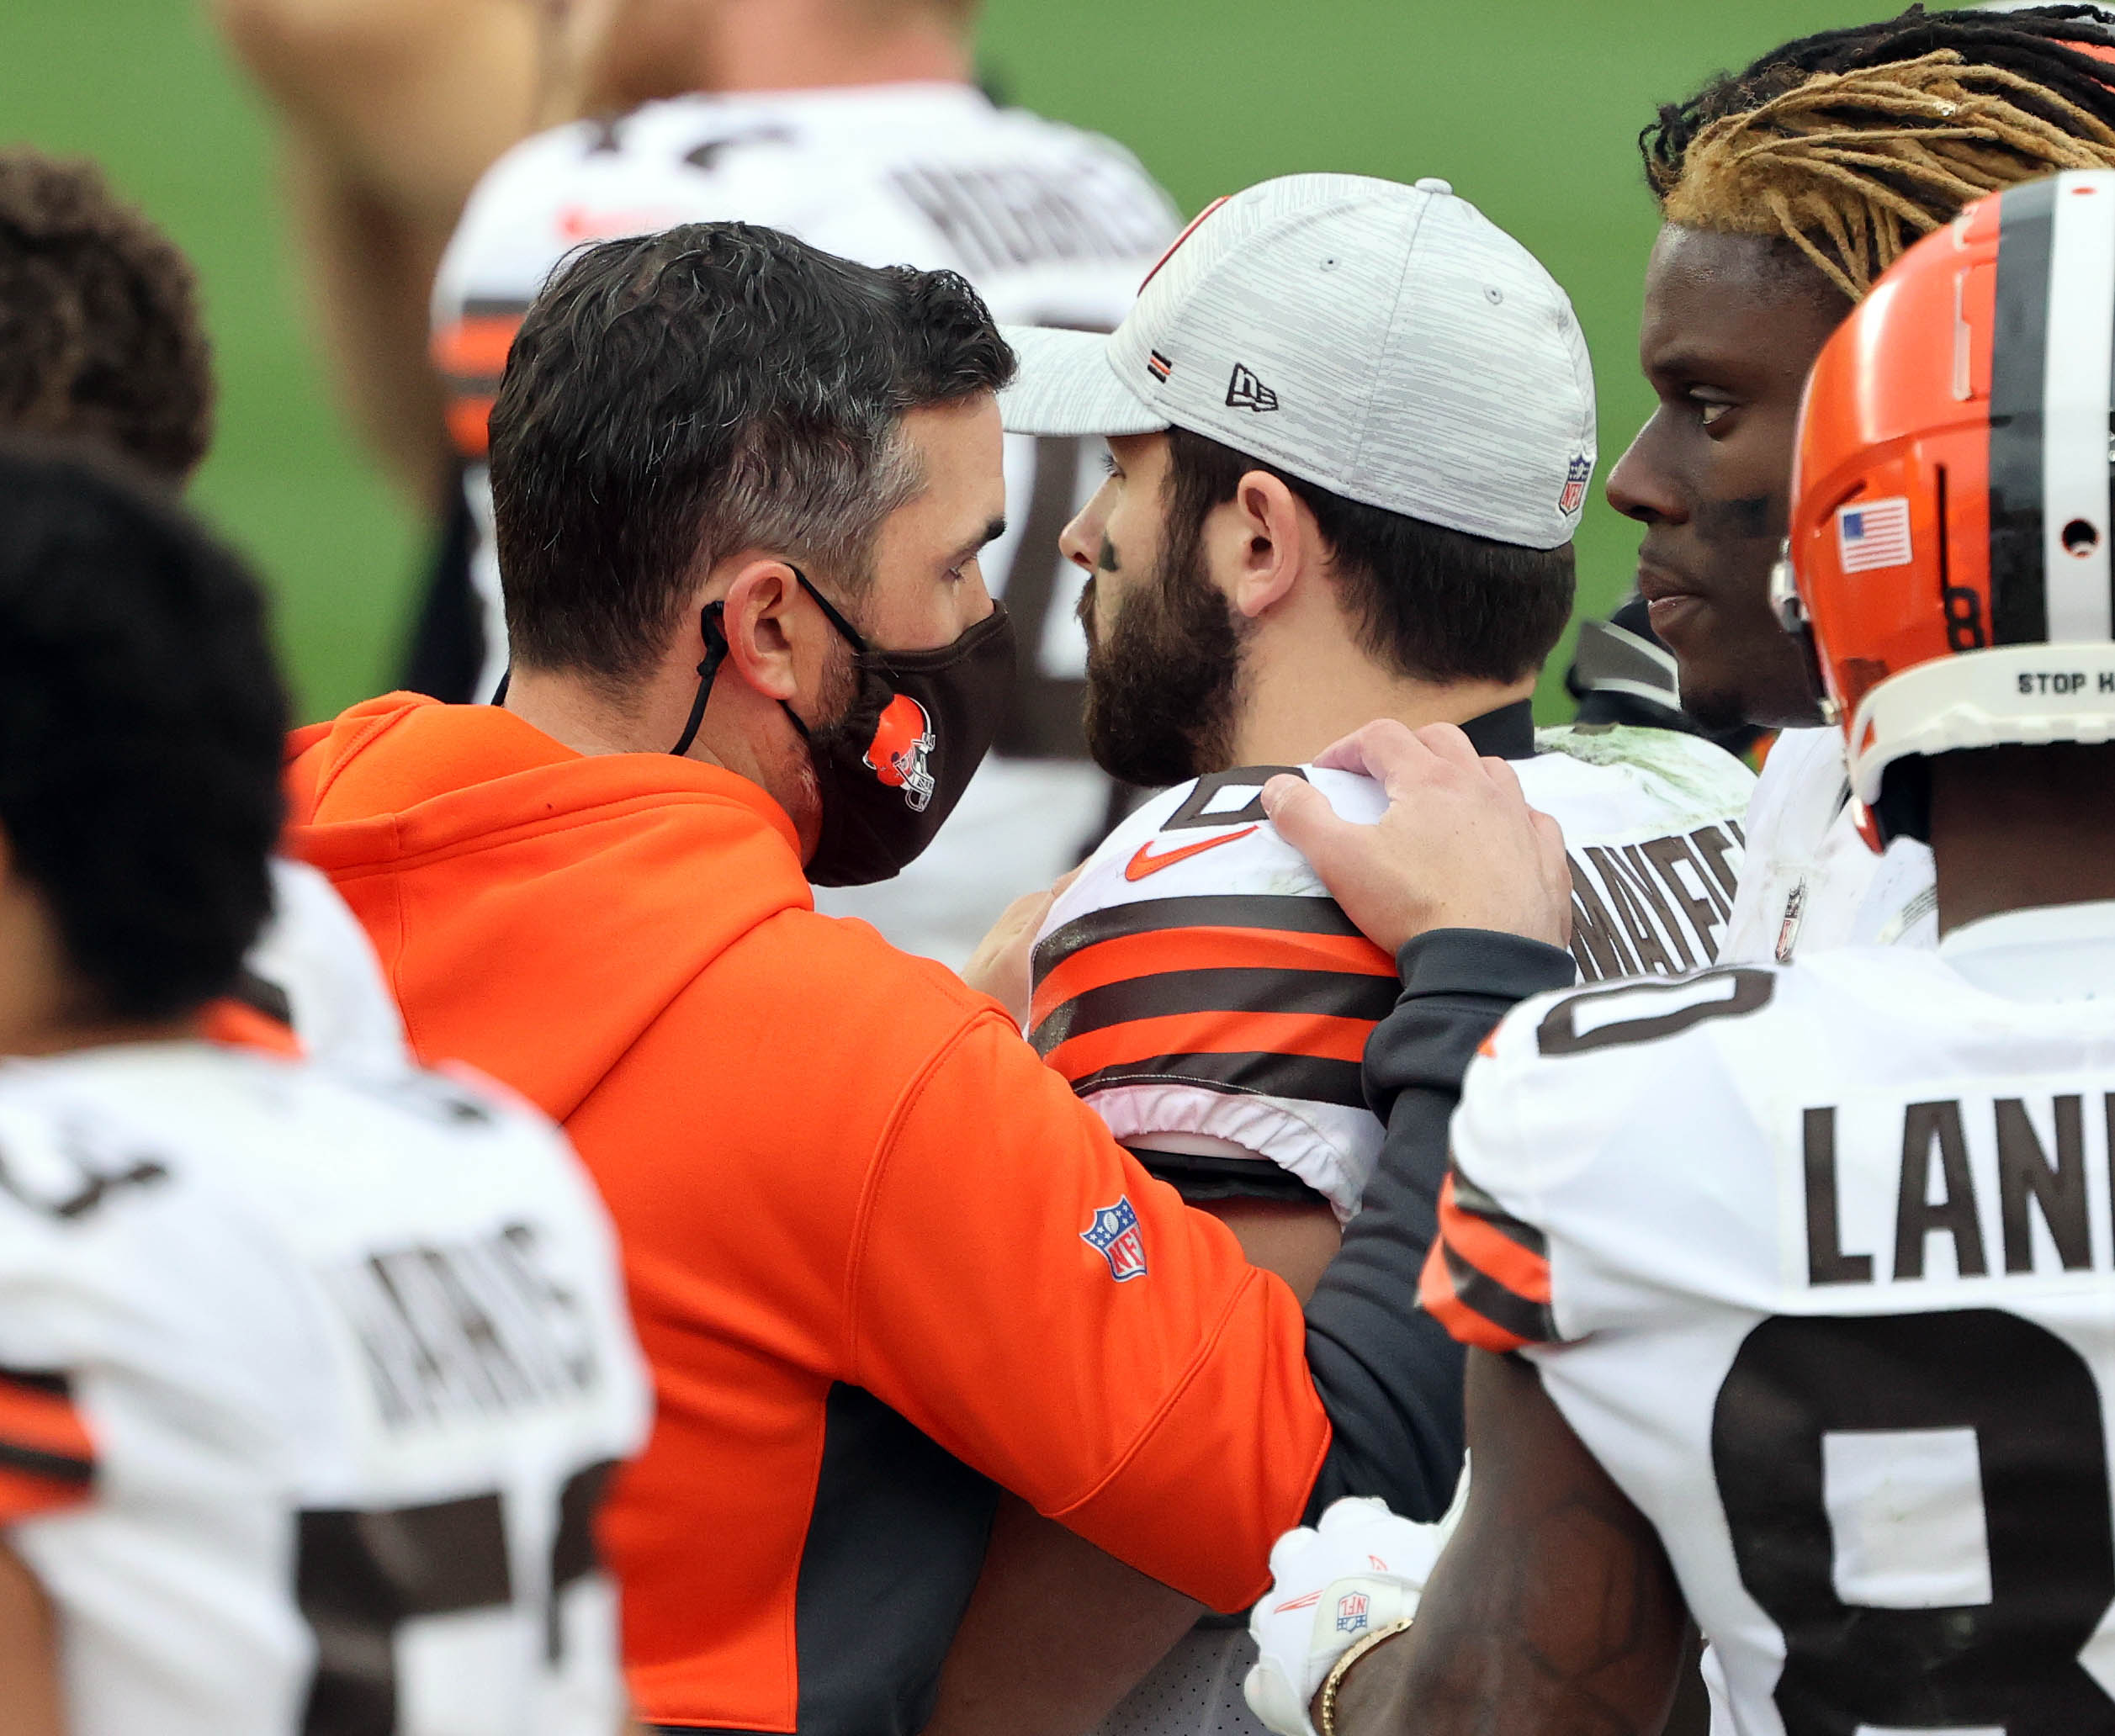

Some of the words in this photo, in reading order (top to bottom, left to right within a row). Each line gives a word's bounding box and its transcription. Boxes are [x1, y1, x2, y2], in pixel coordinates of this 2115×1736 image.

[2017, 673, 2086, 695] STOP
[1564, 819, 1746, 982] MAYFI
[1803, 1093, 2115, 1287] LAN
[1338, 1595, 1367, 1616] NFL
